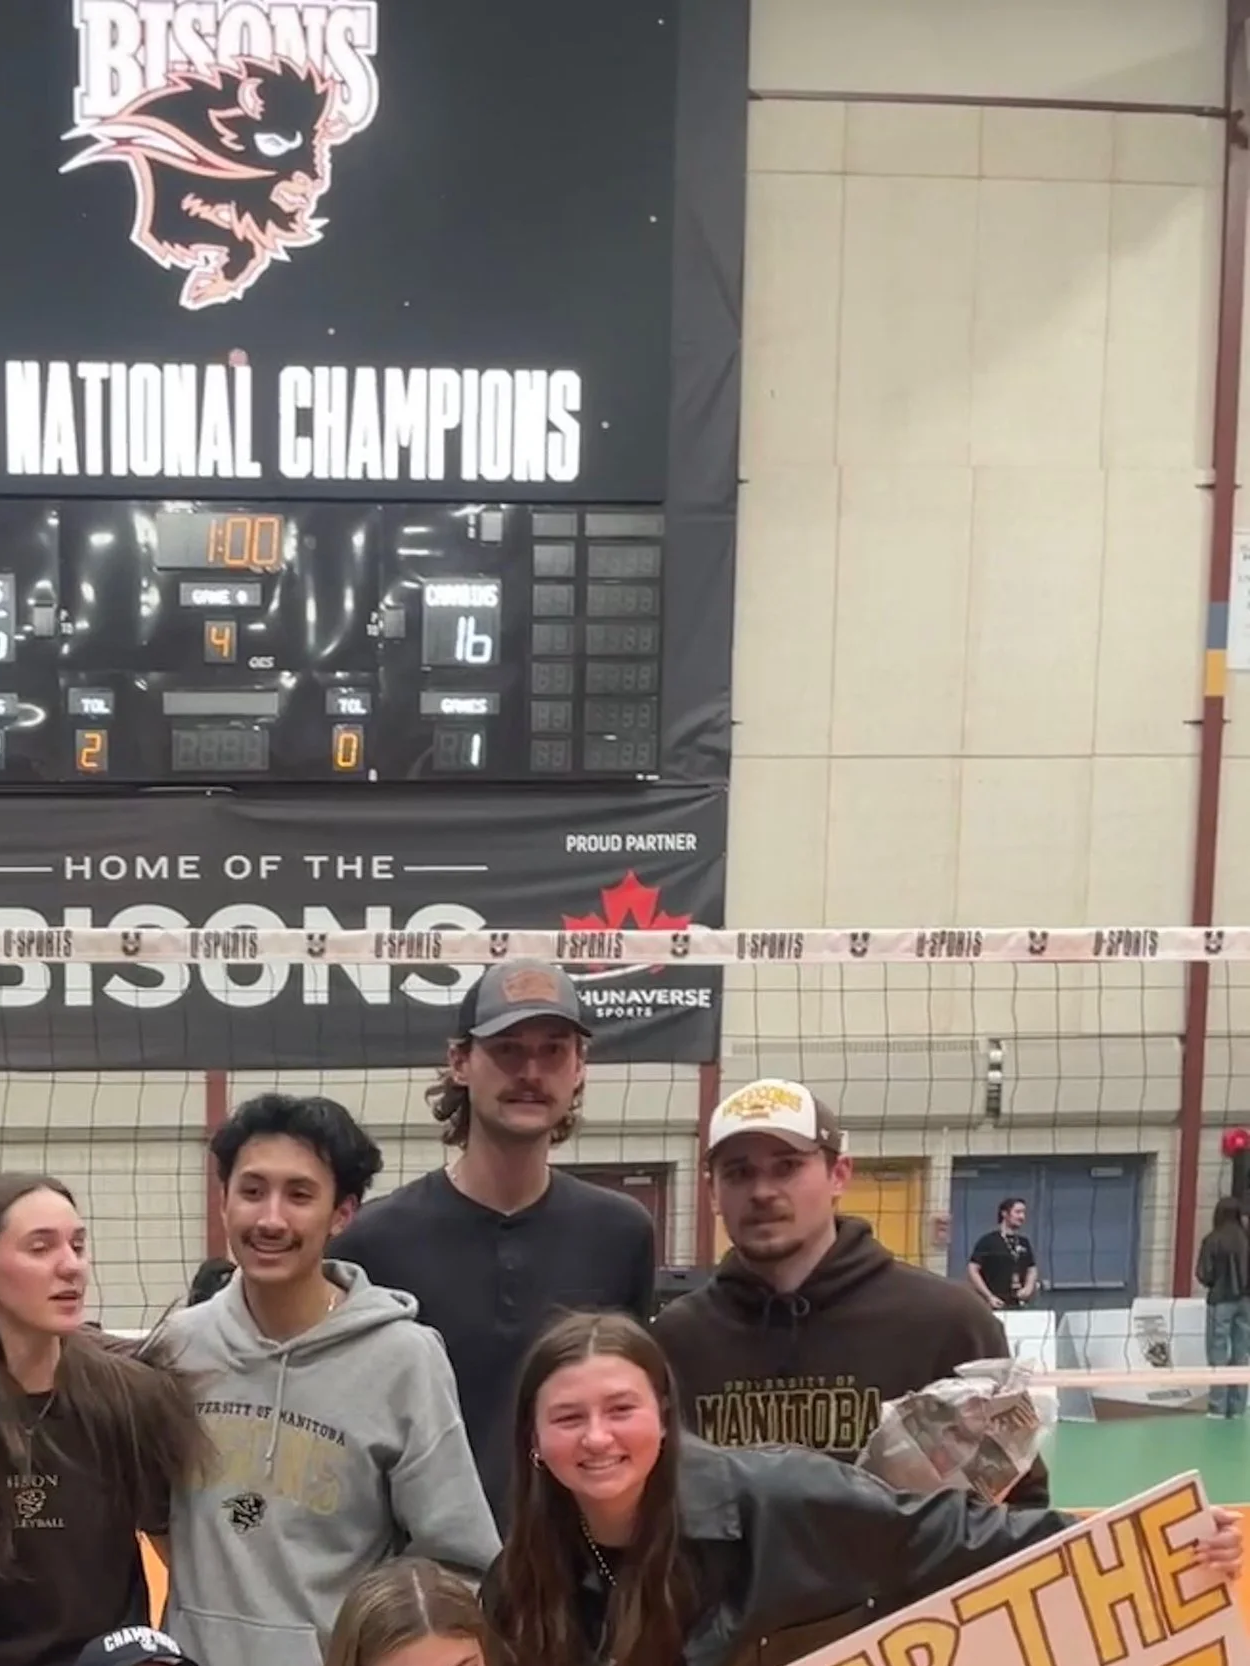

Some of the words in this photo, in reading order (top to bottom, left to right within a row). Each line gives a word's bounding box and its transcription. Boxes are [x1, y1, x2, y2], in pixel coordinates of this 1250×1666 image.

[74, 0, 379, 134] BISONS
[5, 360, 261, 479] NATIONAL
[278, 364, 582, 483] CHAMPIONS
[208, 516, 279, 566] 1:00
[210, 625, 231, 658] 4
[80, 732, 102, 768] 2
[337, 733, 358, 768] 0
[470, 733, 481, 767] 1
[566, 834, 622, 853] PROUD
[626, 832, 698, 852] PARTNER
[64, 855, 201, 880] HOME
[224, 855, 282, 881] OF
[304, 855, 396, 880] THE
[596, 1006, 653, 1019] SPORTS
[278, 1409, 347, 1447] MANITOBA
[696, 1388, 882, 1451] MANITOBA
